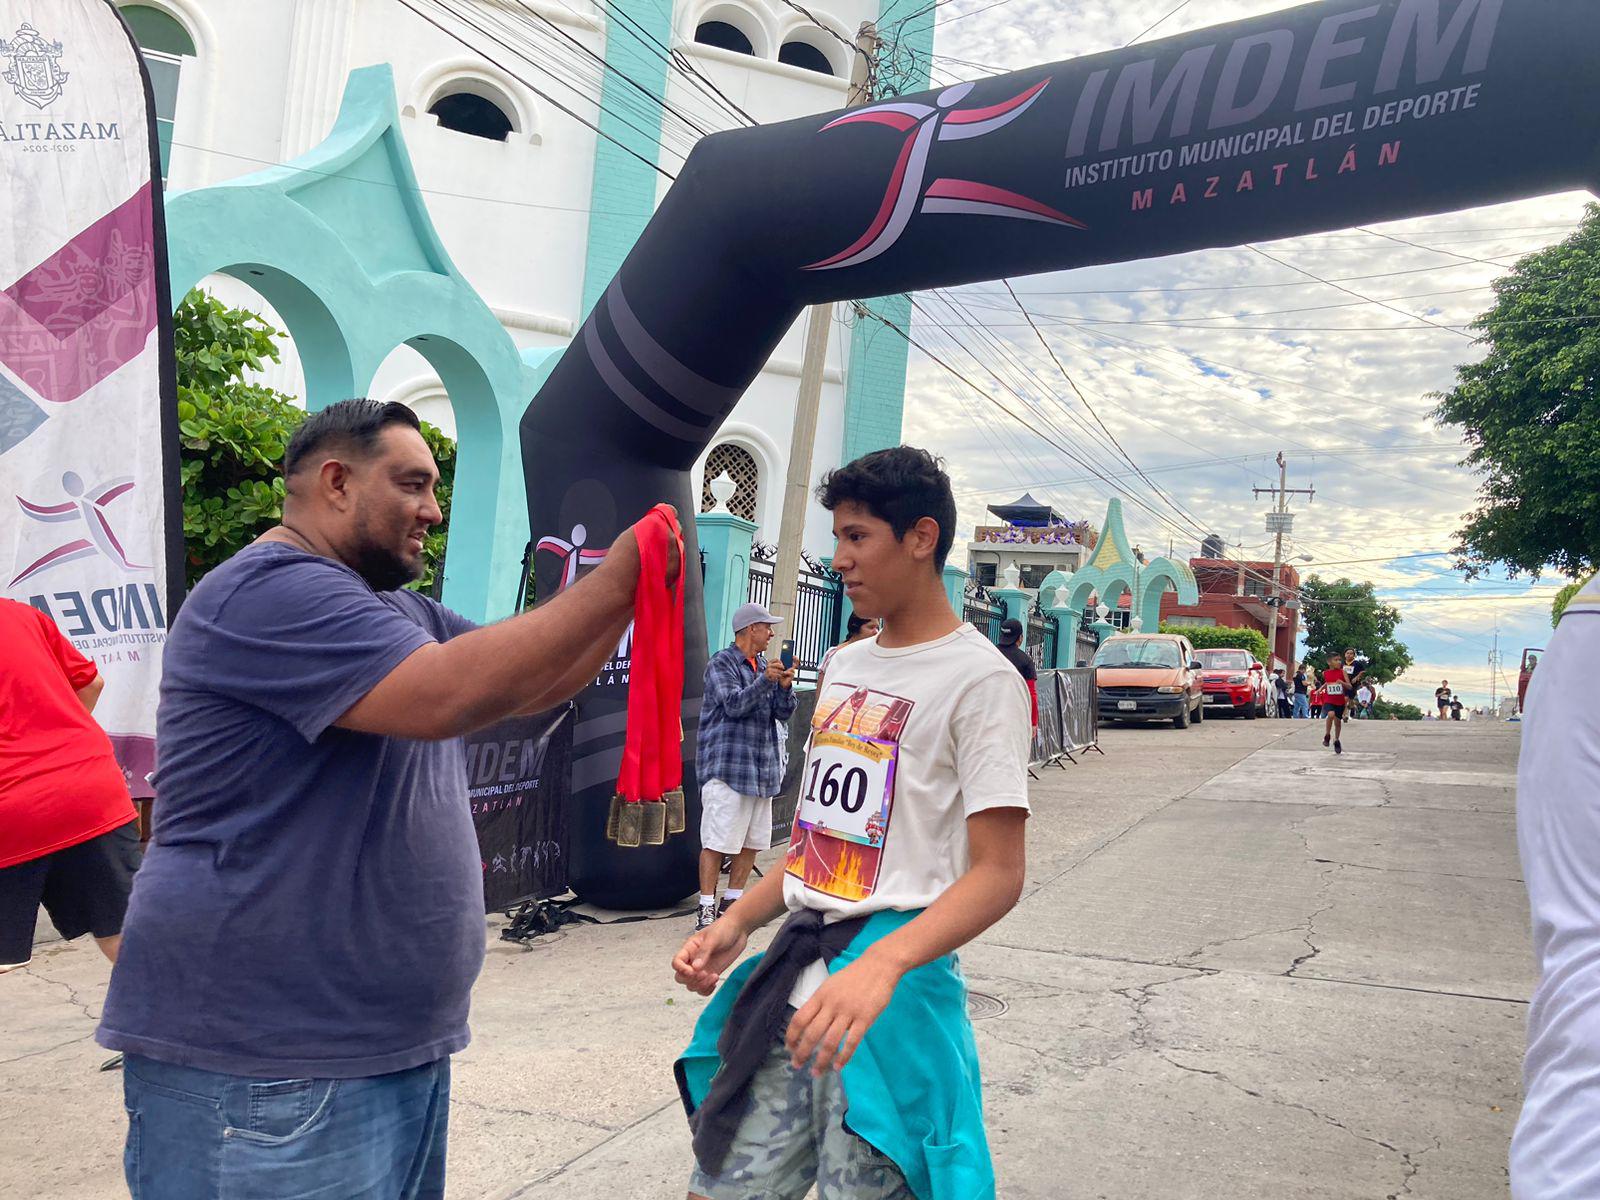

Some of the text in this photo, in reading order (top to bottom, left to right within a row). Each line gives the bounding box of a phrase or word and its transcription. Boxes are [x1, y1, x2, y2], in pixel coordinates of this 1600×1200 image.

[1064, 0, 1503, 158] IMDEM
[1065, 83, 1482, 188] INSTITUTO MUNICIPAL DEL DEPORTE
[1131, 141, 1400, 211] MAZATLÁN
[1328, 685, 1341, 693] 110
[805, 757, 868, 814] 160
